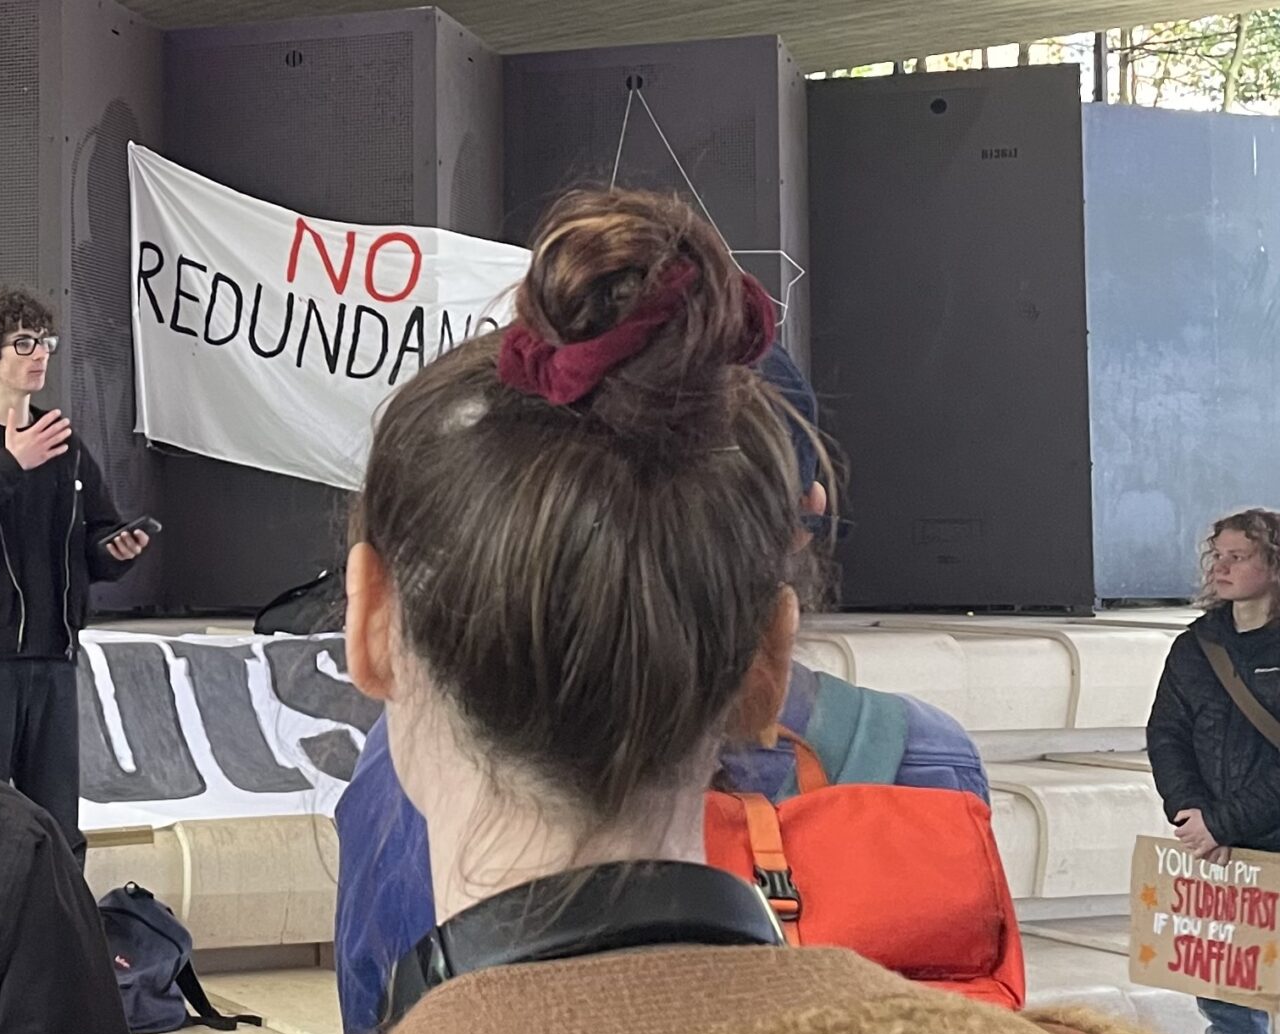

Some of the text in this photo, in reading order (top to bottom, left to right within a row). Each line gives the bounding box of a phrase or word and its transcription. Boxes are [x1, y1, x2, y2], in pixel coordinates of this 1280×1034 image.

[286, 216, 422, 303] NO
[1155, 844, 1193, 878] YOU
[1235, 861, 1261, 885] PUT
[1153, 912, 1236, 944] IF YOU PUT
